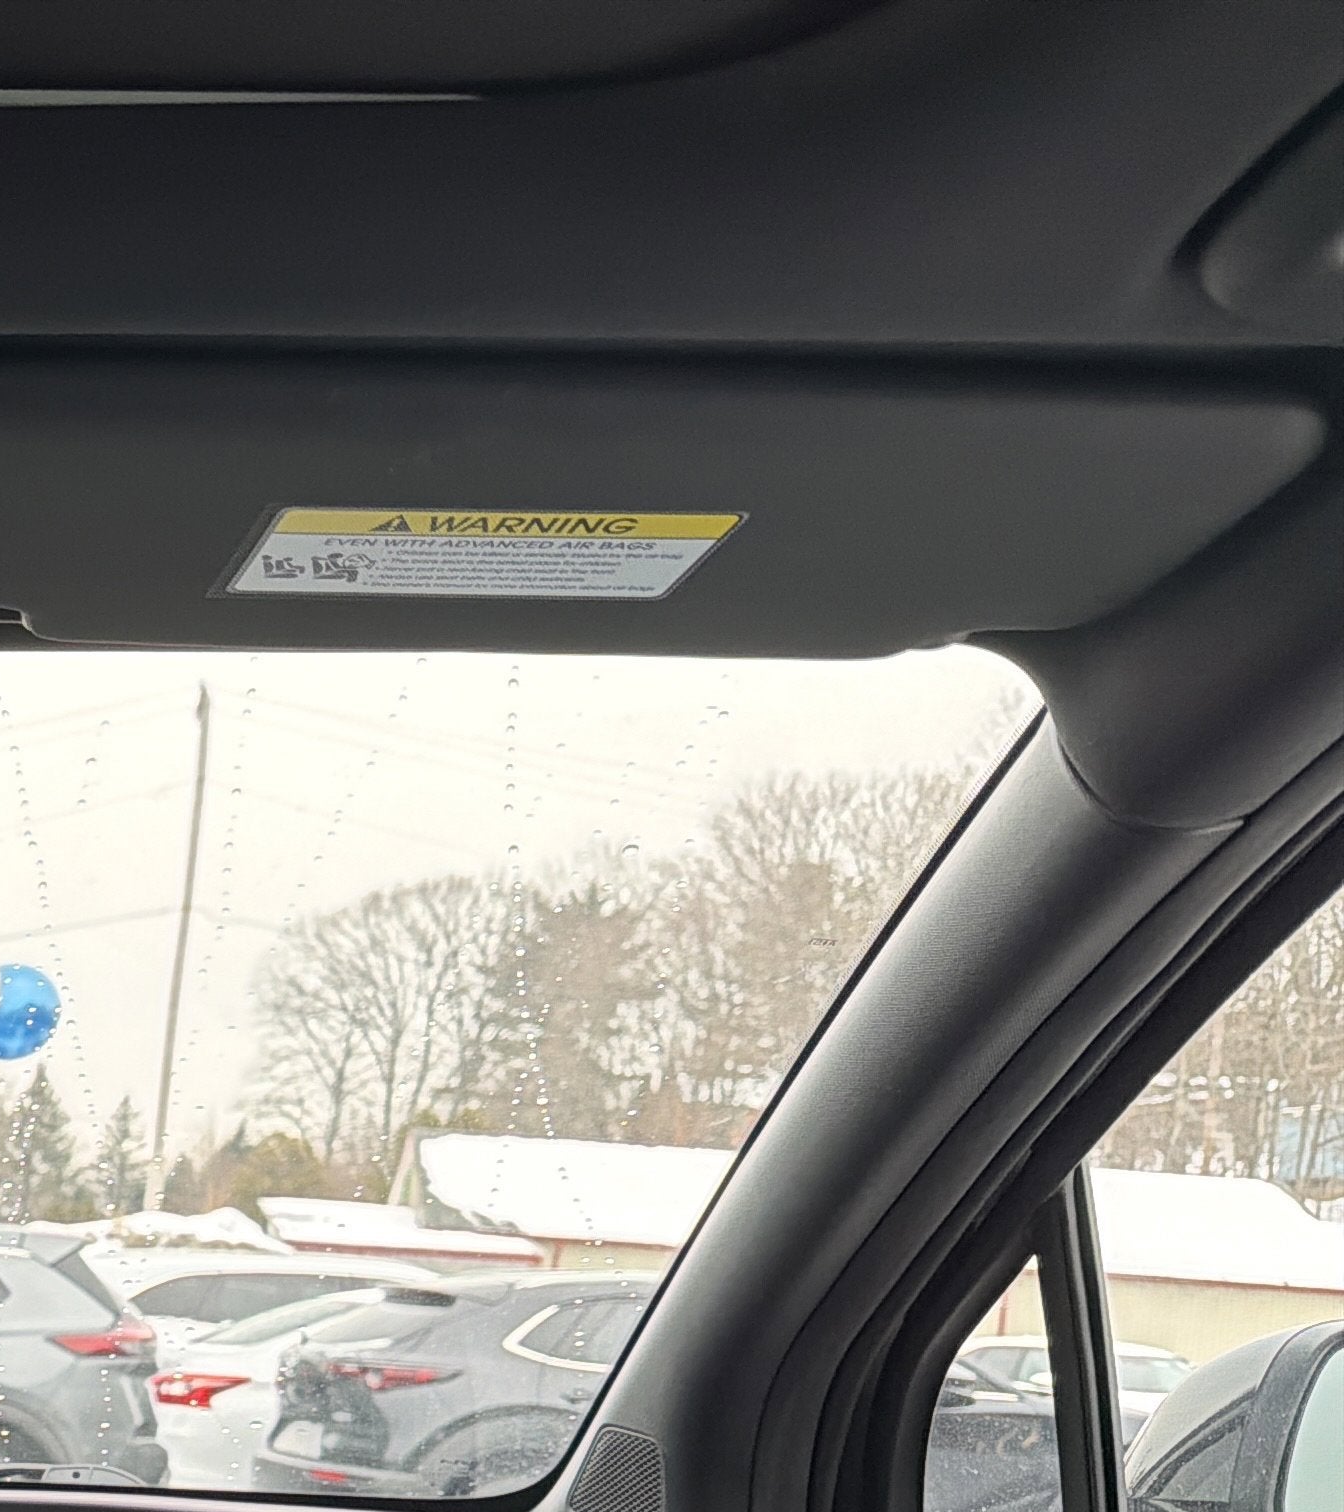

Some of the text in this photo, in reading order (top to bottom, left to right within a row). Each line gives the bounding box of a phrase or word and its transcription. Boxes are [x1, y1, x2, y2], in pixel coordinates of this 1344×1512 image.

[428, 516, 639, 535] WARNING
[324, 537, 657, 551] EVEN WITH ADVANCED AIR BAGS
